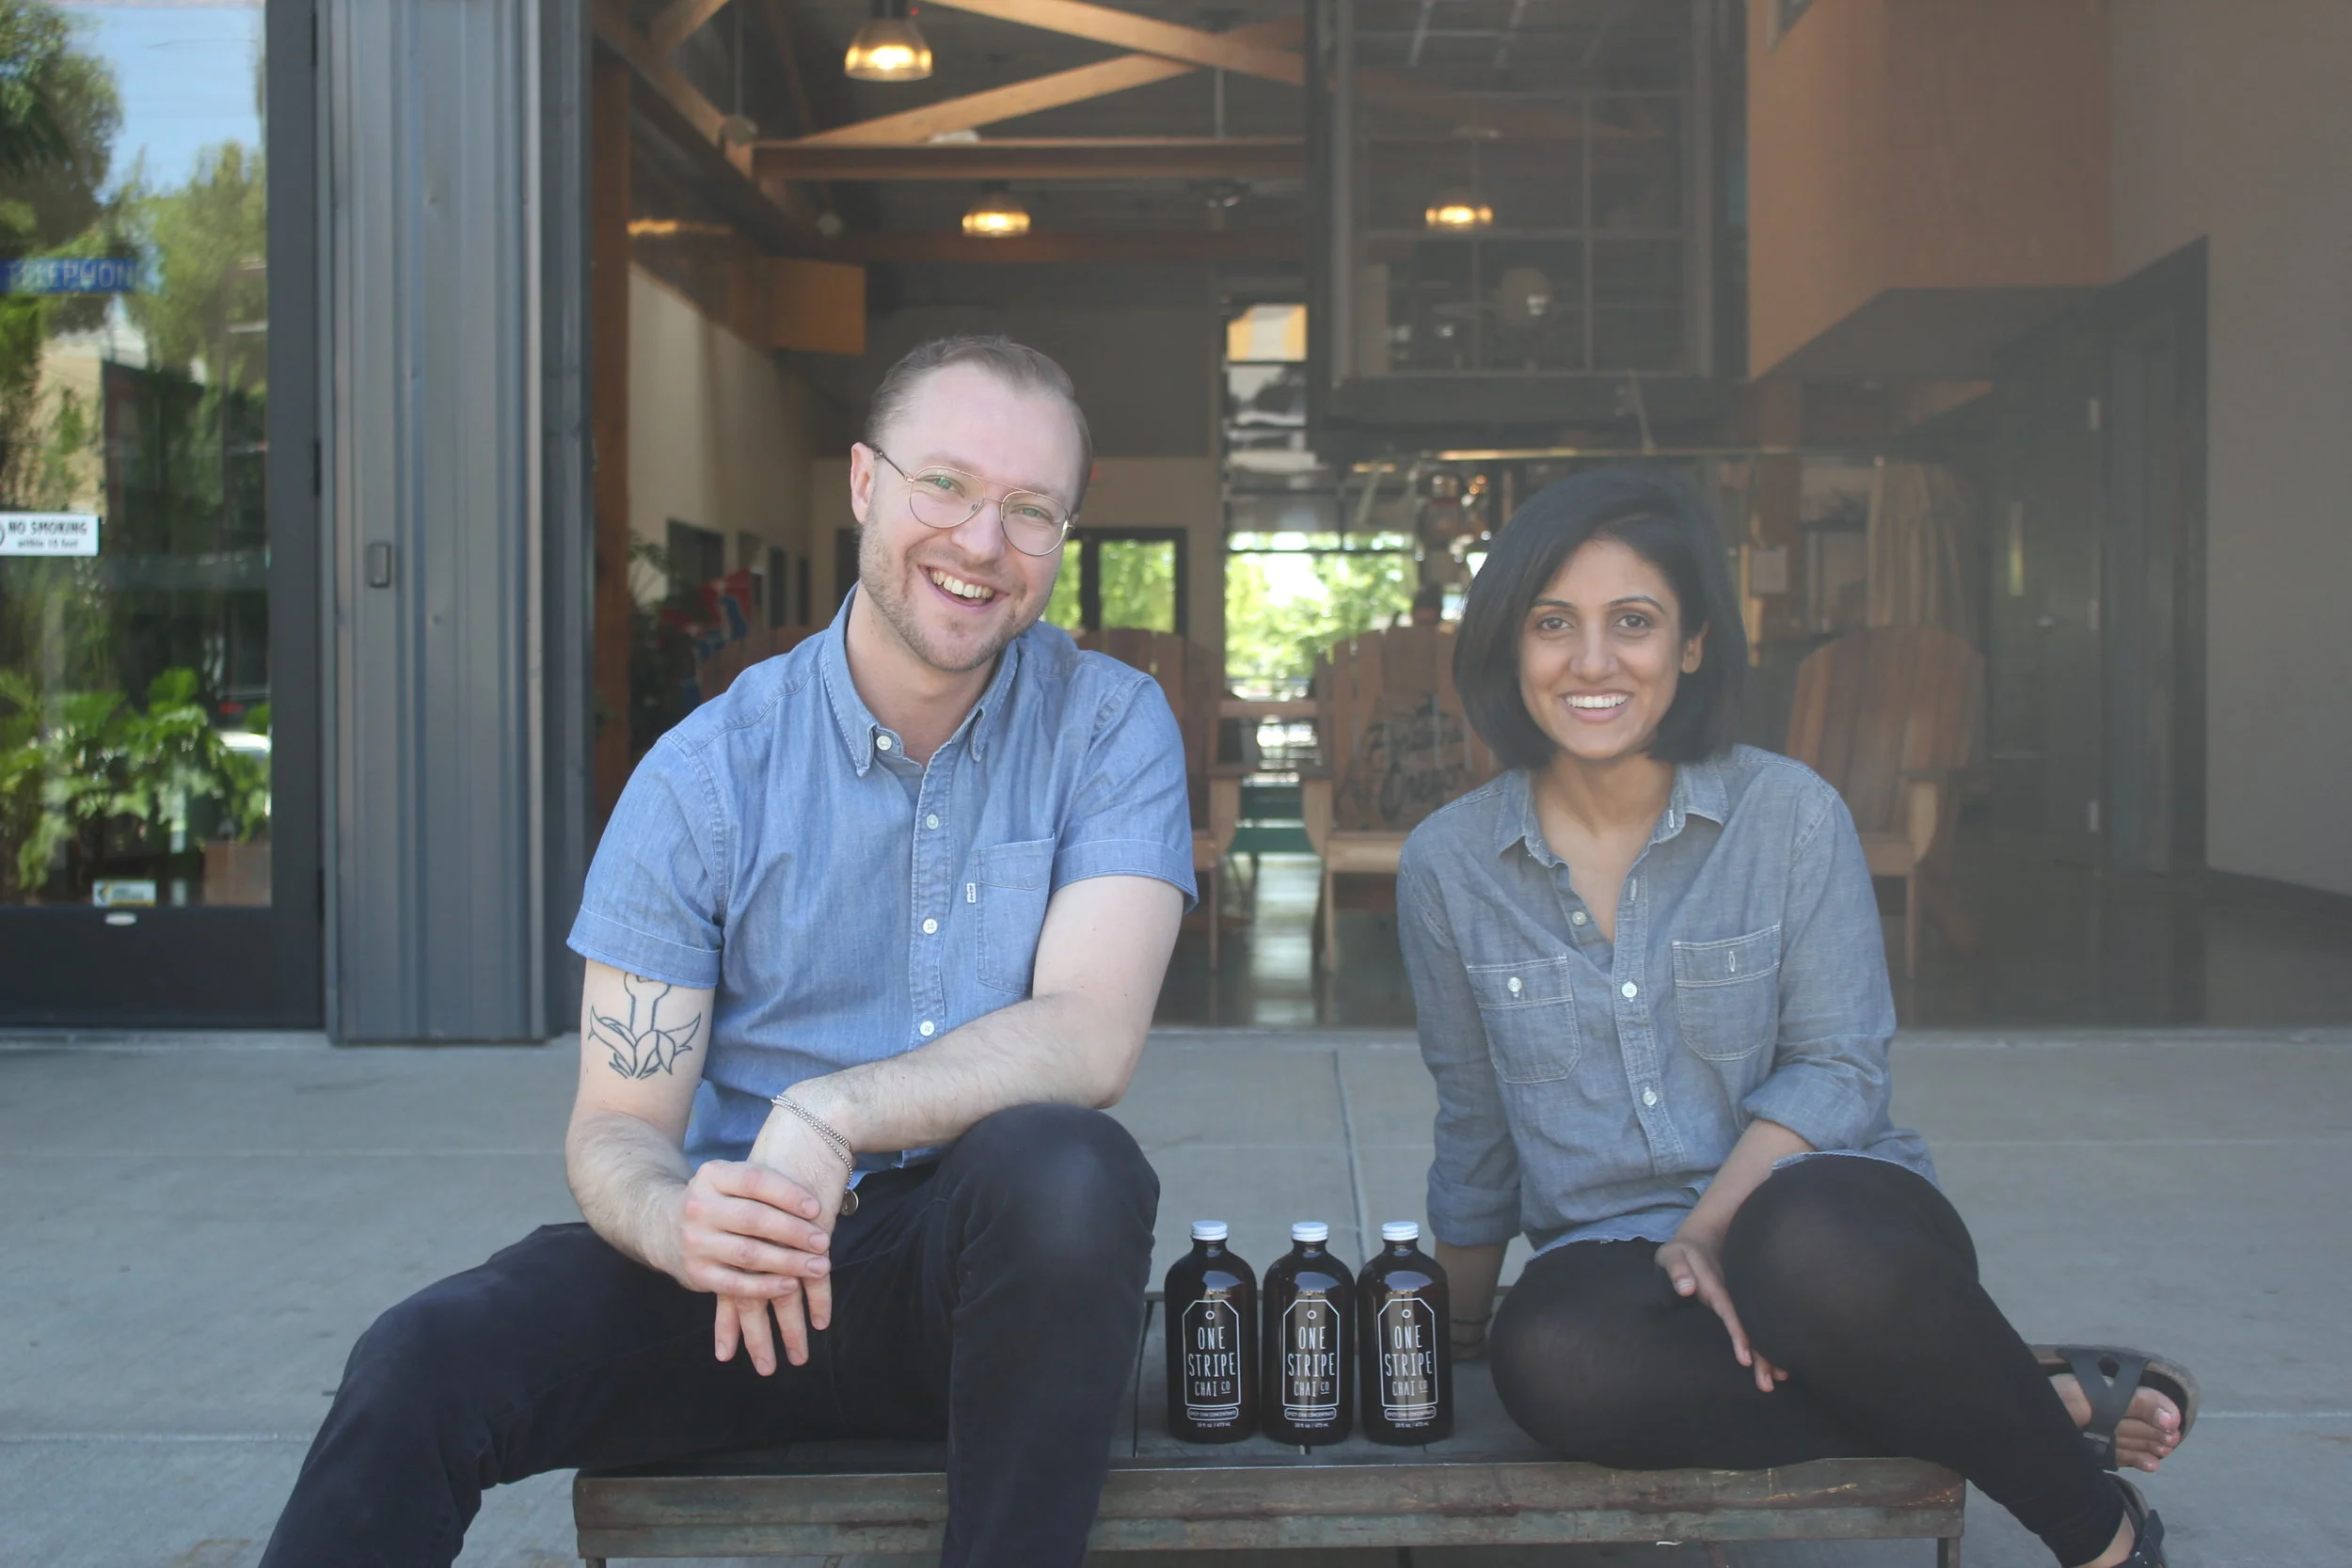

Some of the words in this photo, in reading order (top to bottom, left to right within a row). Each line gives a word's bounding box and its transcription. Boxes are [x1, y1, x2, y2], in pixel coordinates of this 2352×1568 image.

[8, 520, 26, 534] NO
[30, 520, 87, 534] SMOKING
[1198, 1327, 1226, 1350] ONE
[1298, 1326, 1327, 1350] ONE
[1394, 1324, 1422, 1349] ONE
[1188, 1353, 1236, 1377] STRIPE
[1287, 1353, 1336, 1377] STRIPE
[1384, 1351, 1433, 1377] STRIPE
[1195, 1381, 1217, 1397] CHAI
[1221, 1381, 1231, 1391] CO
[1294, 1381, 1317, 1397] CHAI
[1320, 1381, 1330, 1391] CO
[1392, 1380, 1415, 1396] CHAI
